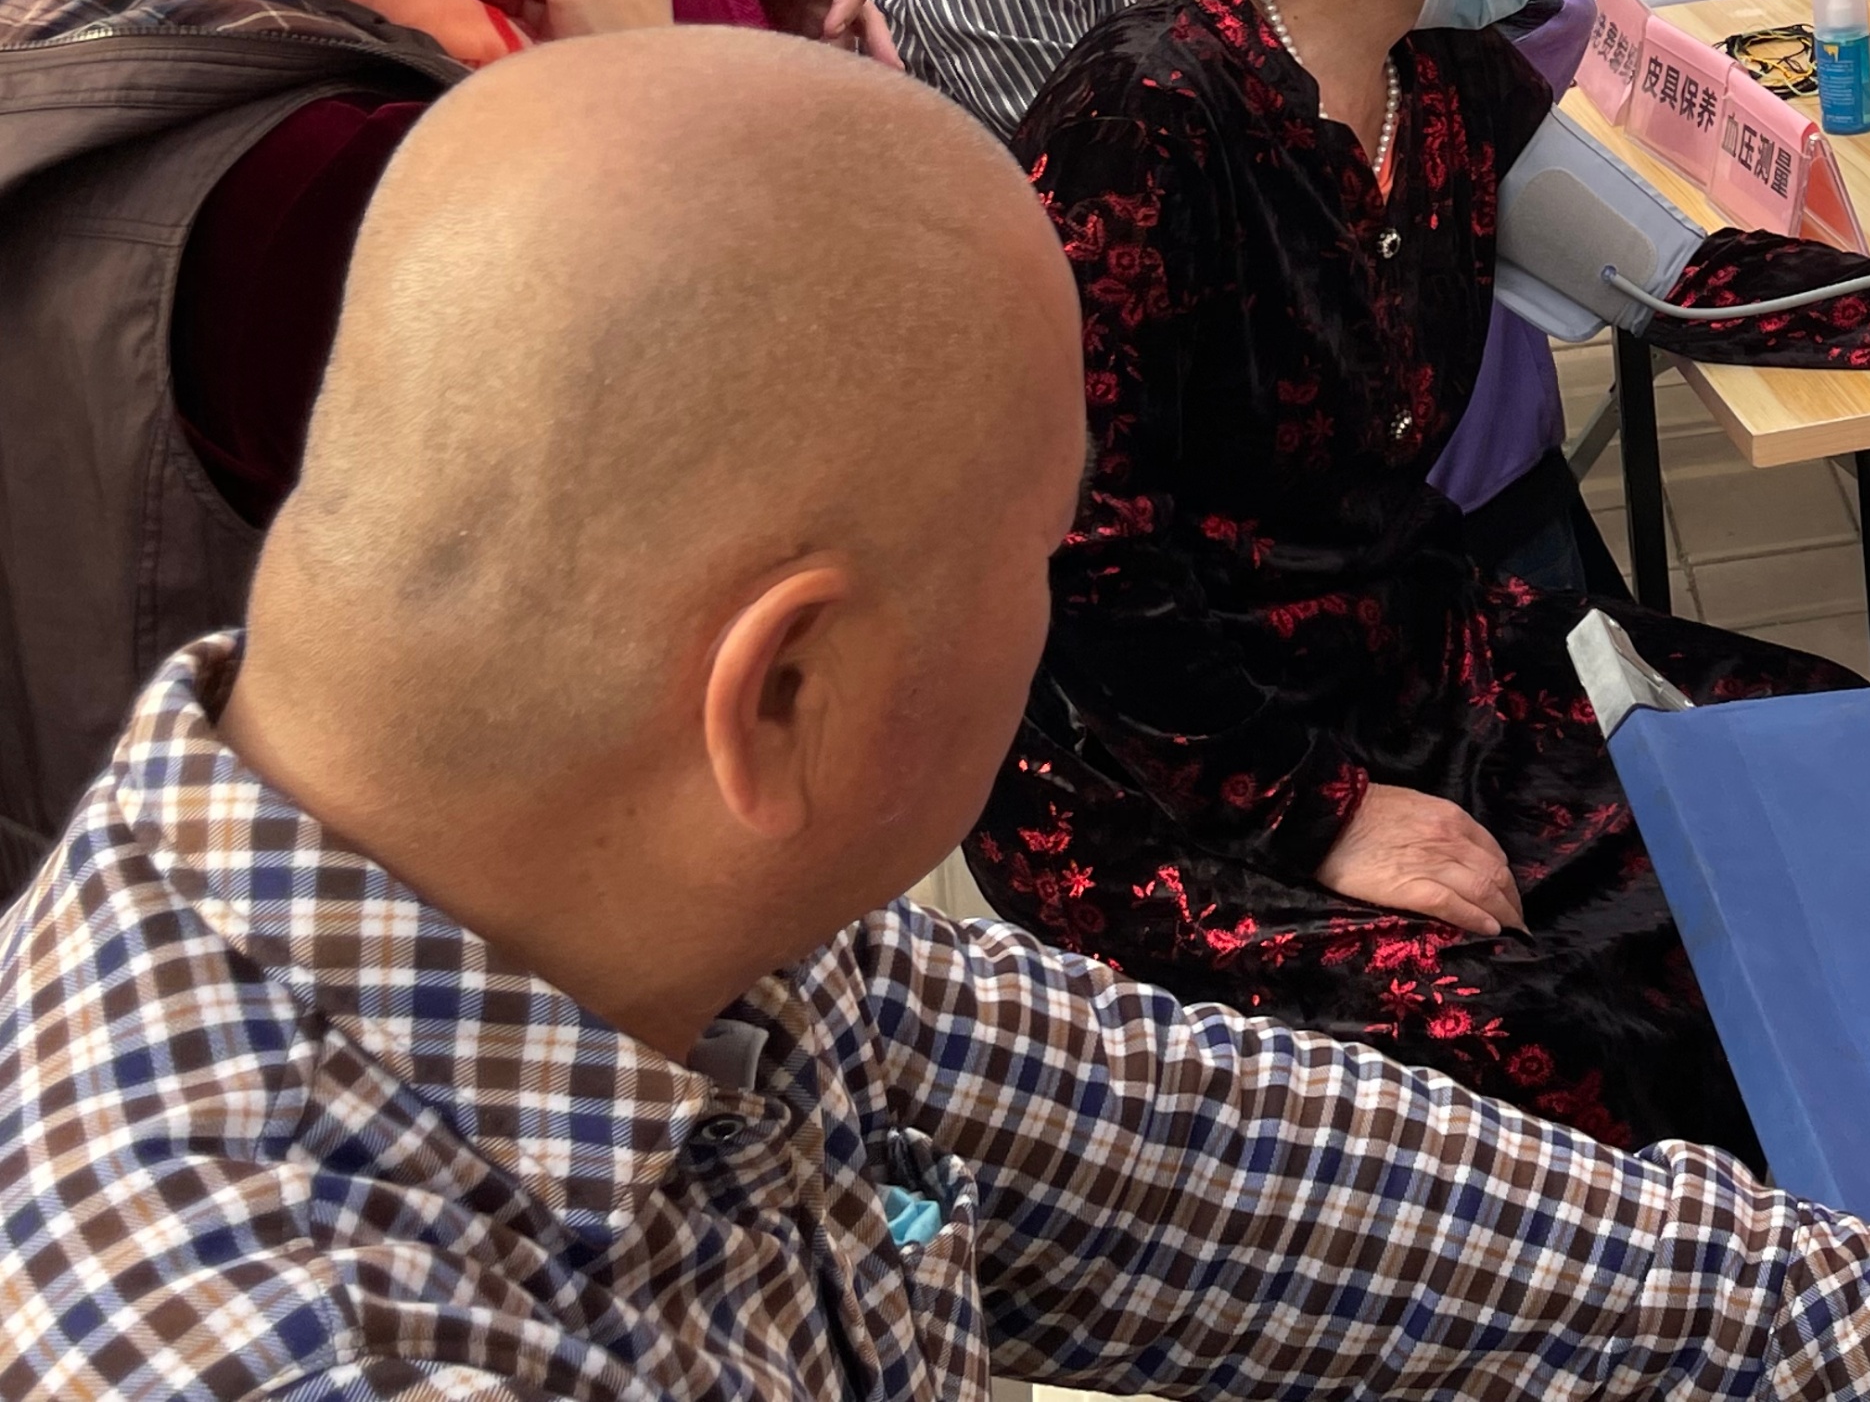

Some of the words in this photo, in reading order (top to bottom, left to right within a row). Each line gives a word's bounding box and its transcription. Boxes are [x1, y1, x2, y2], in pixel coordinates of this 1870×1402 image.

[1641, 55, 1718, 133] 皮具保养
[1721, 111, 1792, 200] 血压测量
